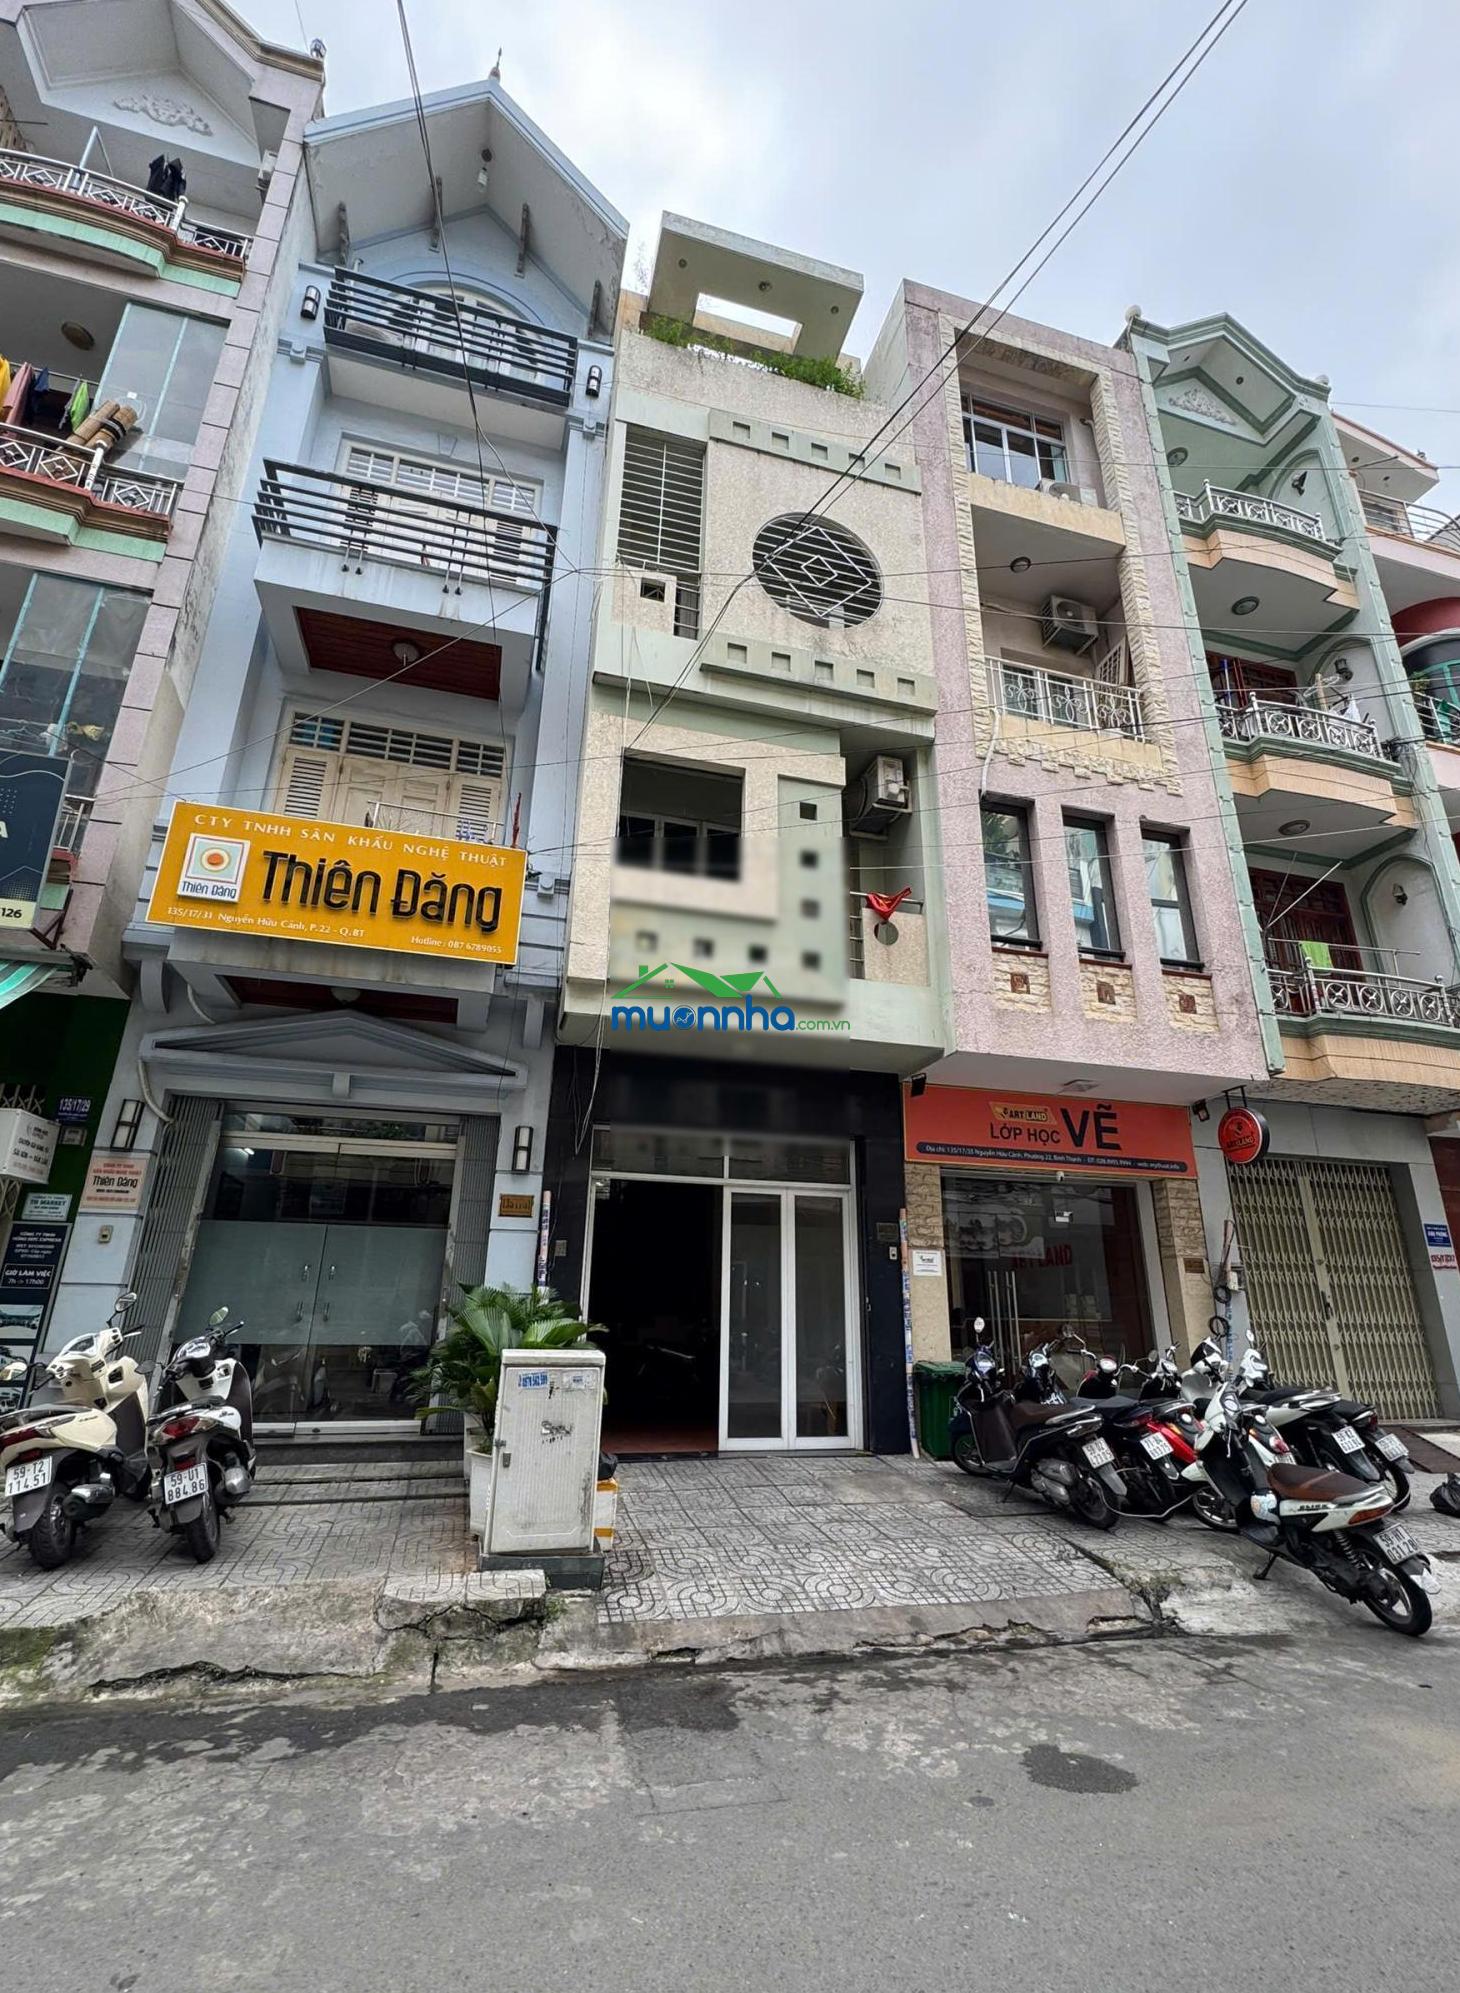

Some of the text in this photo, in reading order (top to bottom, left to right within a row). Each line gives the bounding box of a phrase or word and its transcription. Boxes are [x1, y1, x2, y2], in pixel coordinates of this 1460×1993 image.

[194, 814, 507, 868] CTY TNHH SÂN KHẤU NGHỆ THUẬT
[181, 880, 208, 895] Thiên
[263, 850, 503, 933] Thiên Đăng
[1, 907, 22, 918] 126
[167, 907, 213, 919] 135/17/31
[990, 1122, 1061, 1146] LỚP HỌC
[1060, 1104, 1122, 1151] VẼ
[93, 1175, 115, 1186] Thiên
[13, 1461, 45, 1480] 59-T2
[170, 1468, 200, 1486] 59-U1
[7, 1472, 47, 1494] 114.51
[168, 1481, 206, 1502] 884.86
